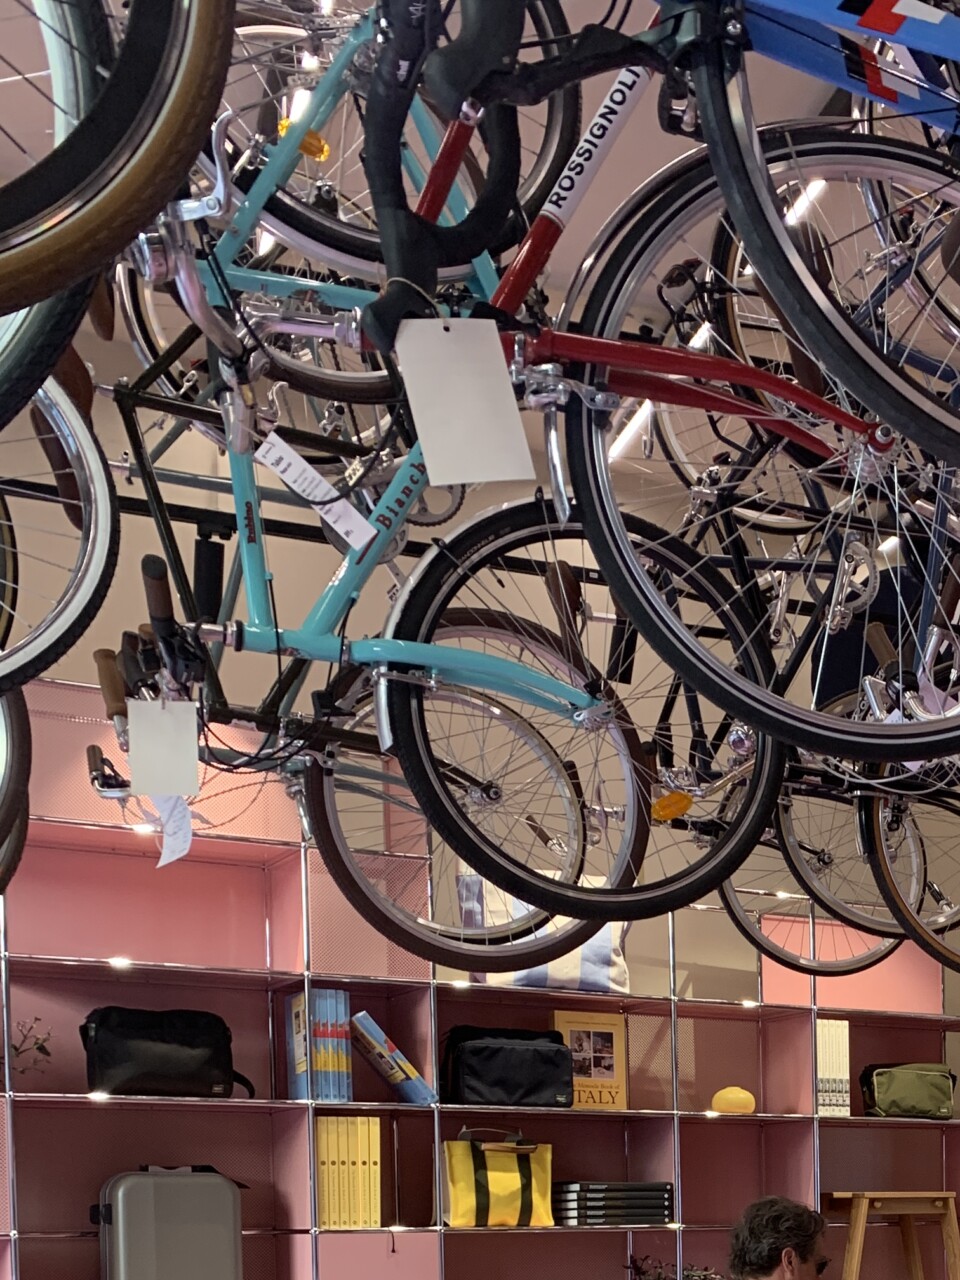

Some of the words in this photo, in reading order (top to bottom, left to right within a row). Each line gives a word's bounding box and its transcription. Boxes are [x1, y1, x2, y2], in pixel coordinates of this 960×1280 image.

[548, 68, 640, 209] ROSSIGNOLI
[375, 452, 428, 530] Bianch
[574, 1090, 620, 1104] TALY
